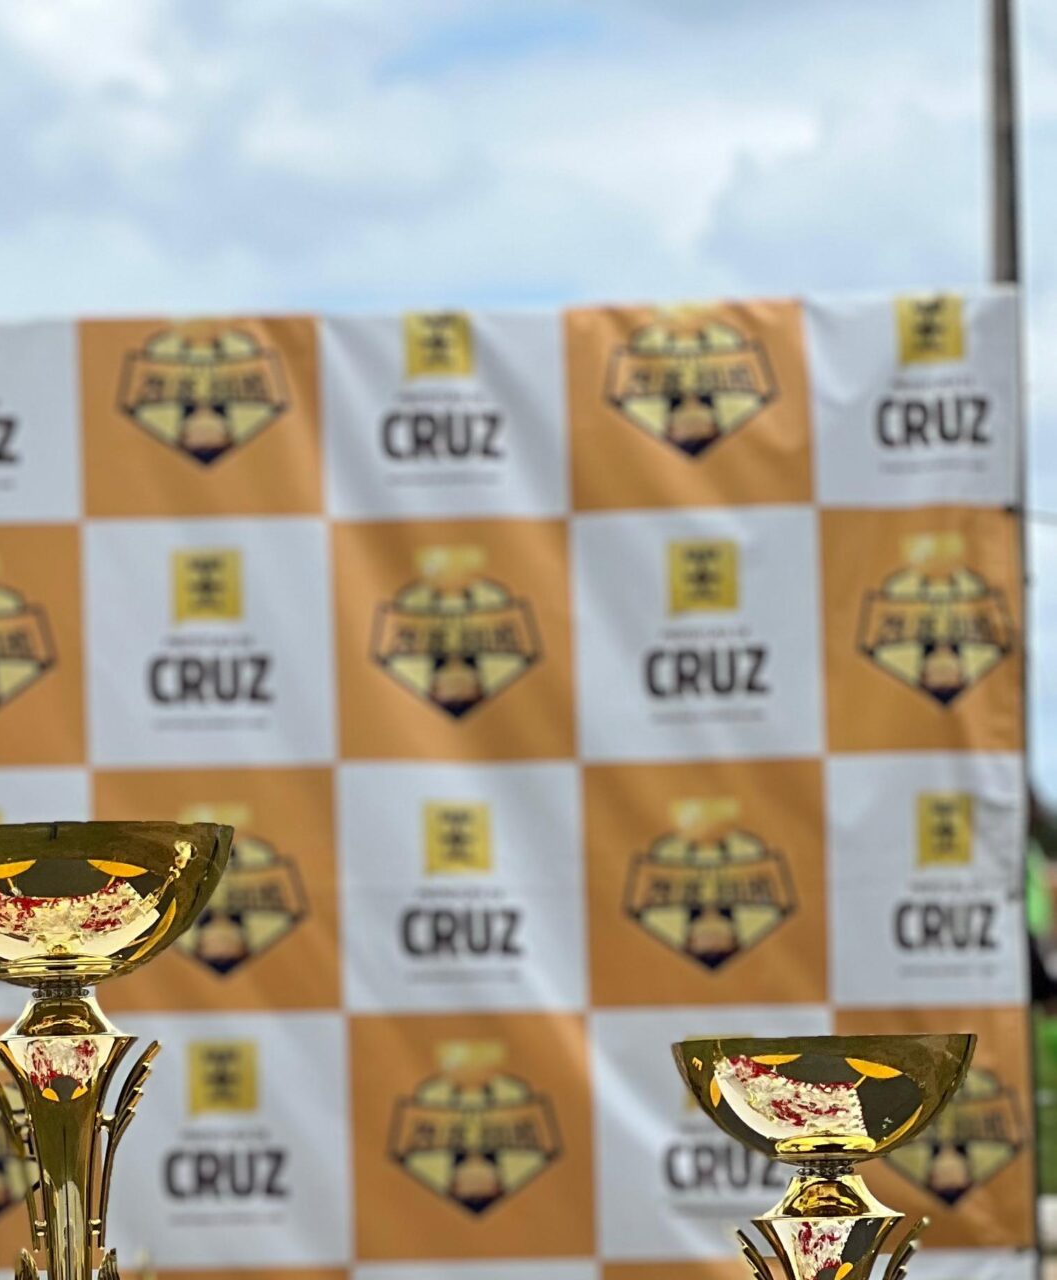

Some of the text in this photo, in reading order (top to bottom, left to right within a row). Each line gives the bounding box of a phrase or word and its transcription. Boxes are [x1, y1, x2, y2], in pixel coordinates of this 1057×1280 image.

[380, 410, 505, 462] CRUZ
[875, 396, 992, 450] CRUZ
[147, 653, 274, 706] CRUZ
[643, 645, 769, 700] CRUZ
[398, 906, 522, 960] CRUZ
[892, 900, 997, 952] CRUZ
[162, 1147, 289, 1202] CRUZ
